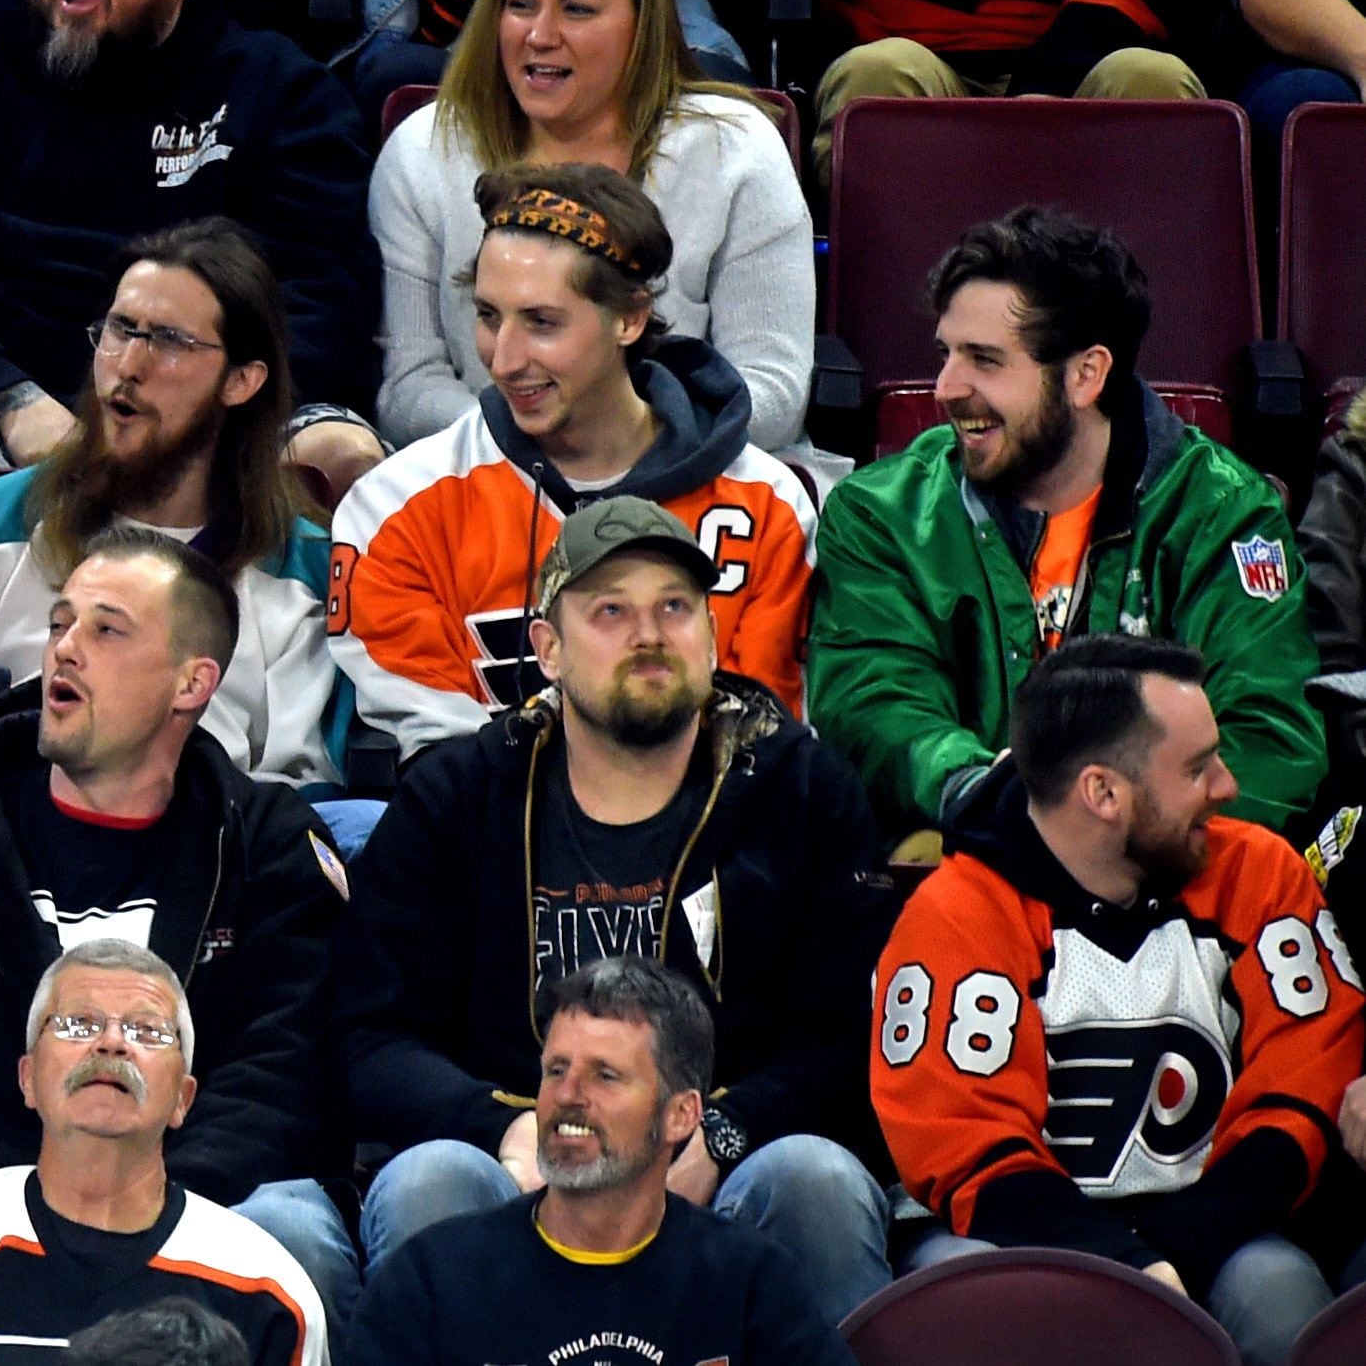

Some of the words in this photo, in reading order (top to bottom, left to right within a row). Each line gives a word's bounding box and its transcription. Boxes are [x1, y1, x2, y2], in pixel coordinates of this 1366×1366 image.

[696, 503, 756, 597] C
[878, 962, 1023, 1077] 88
[548, 1331, 665, 1366] PHILADELPHIA
